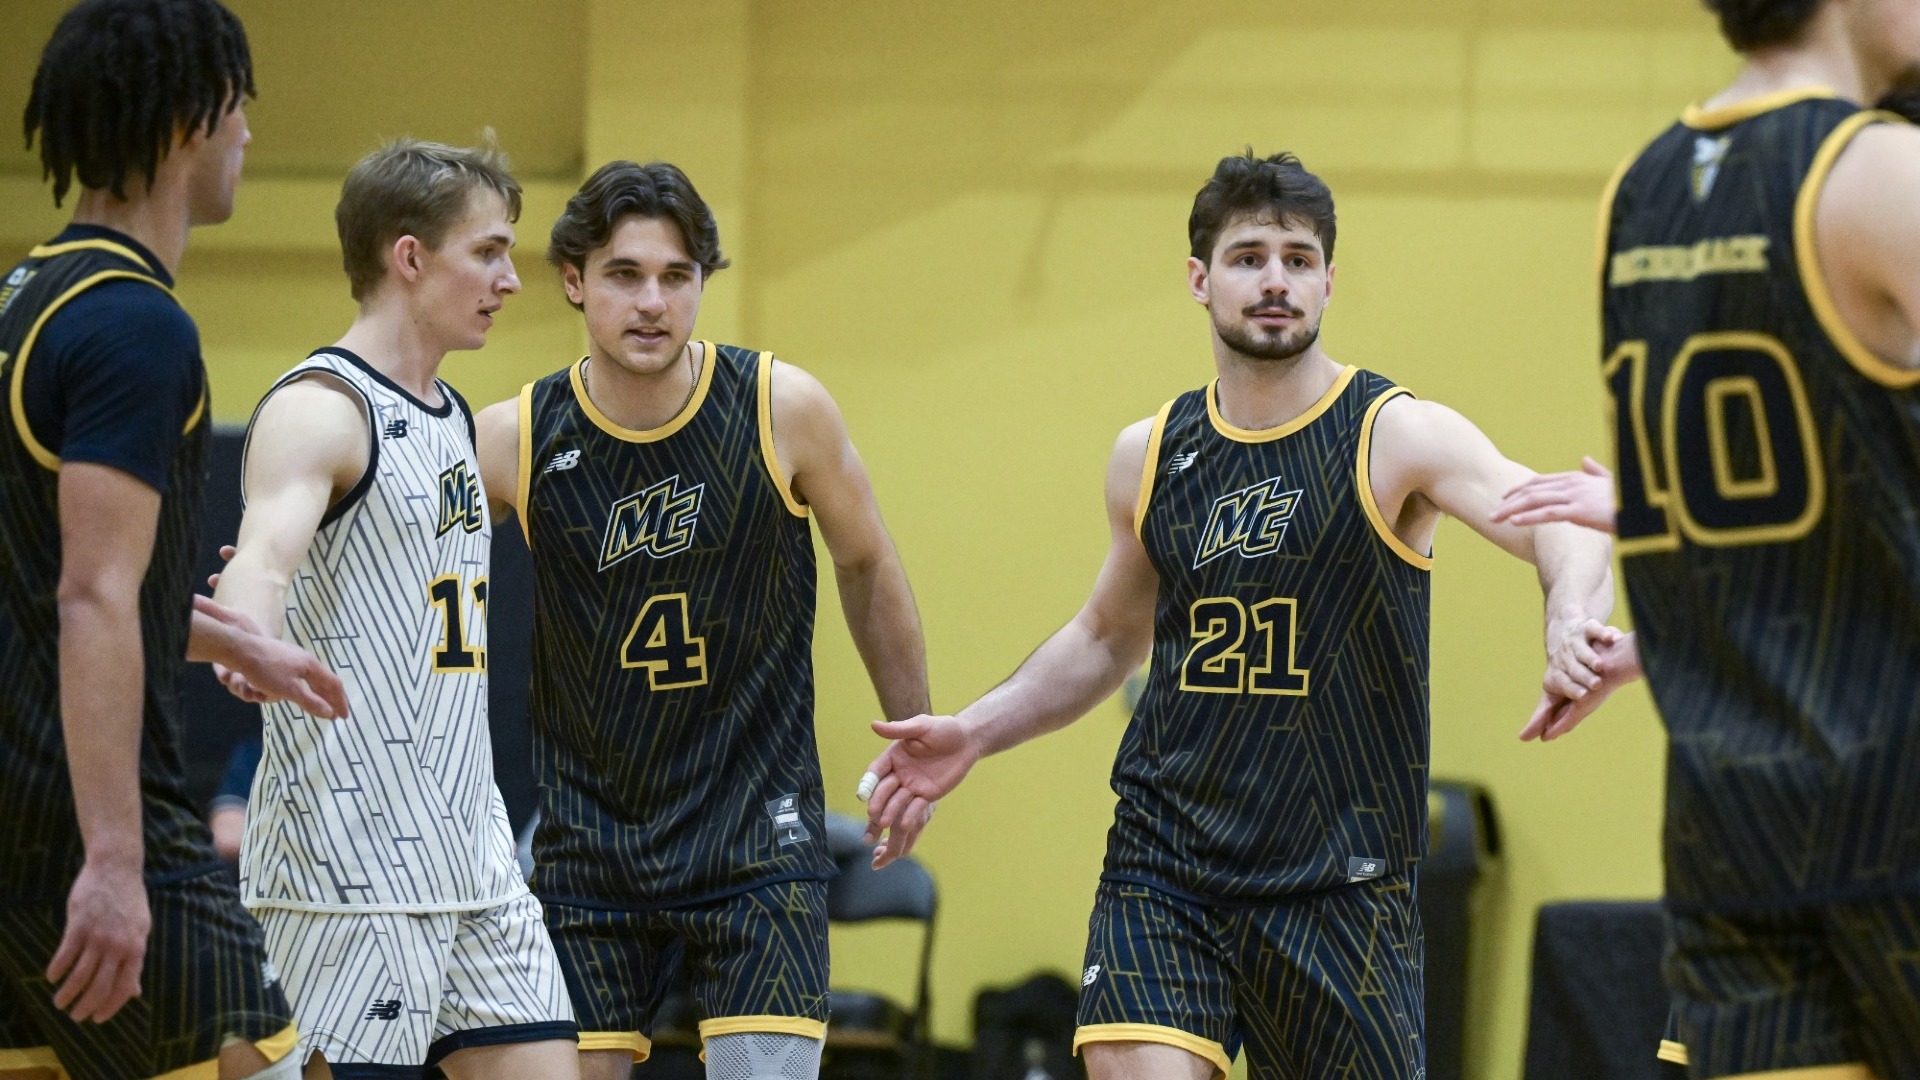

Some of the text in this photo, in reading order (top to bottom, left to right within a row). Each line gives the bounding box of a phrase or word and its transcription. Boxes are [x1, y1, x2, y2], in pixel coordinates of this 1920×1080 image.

[1603, 331, 1827, 557] 10
[620, 592, 708, 692] 4
[1179, 596, 1310, 696] 21
[788, 828, 798, 840] L
